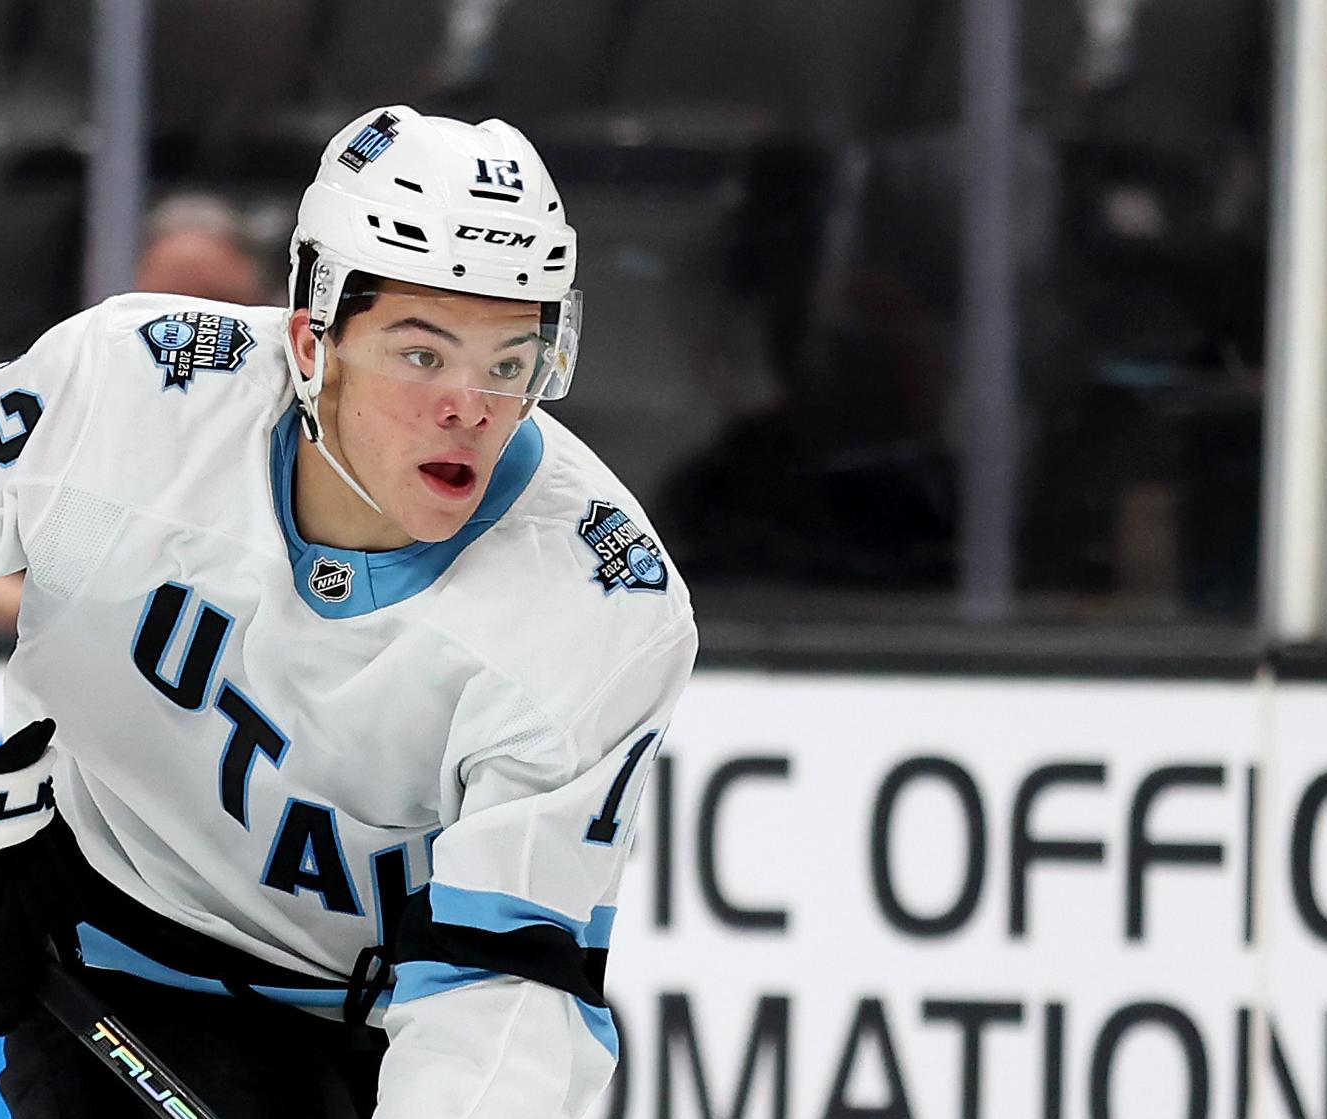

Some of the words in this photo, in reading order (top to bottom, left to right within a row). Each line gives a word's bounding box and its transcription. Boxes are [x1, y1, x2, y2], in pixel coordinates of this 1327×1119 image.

[475, 158, 523, 192] 12
[454, 224, 537, 248] CCM
[162, 323, 180, 345] UTAH
[193, 314, 221, 367] SEASON
[177, 350, 192, 377] 2025
[601, 557, 626, 578] 2024
[317, 573, 345, 590] NHL
